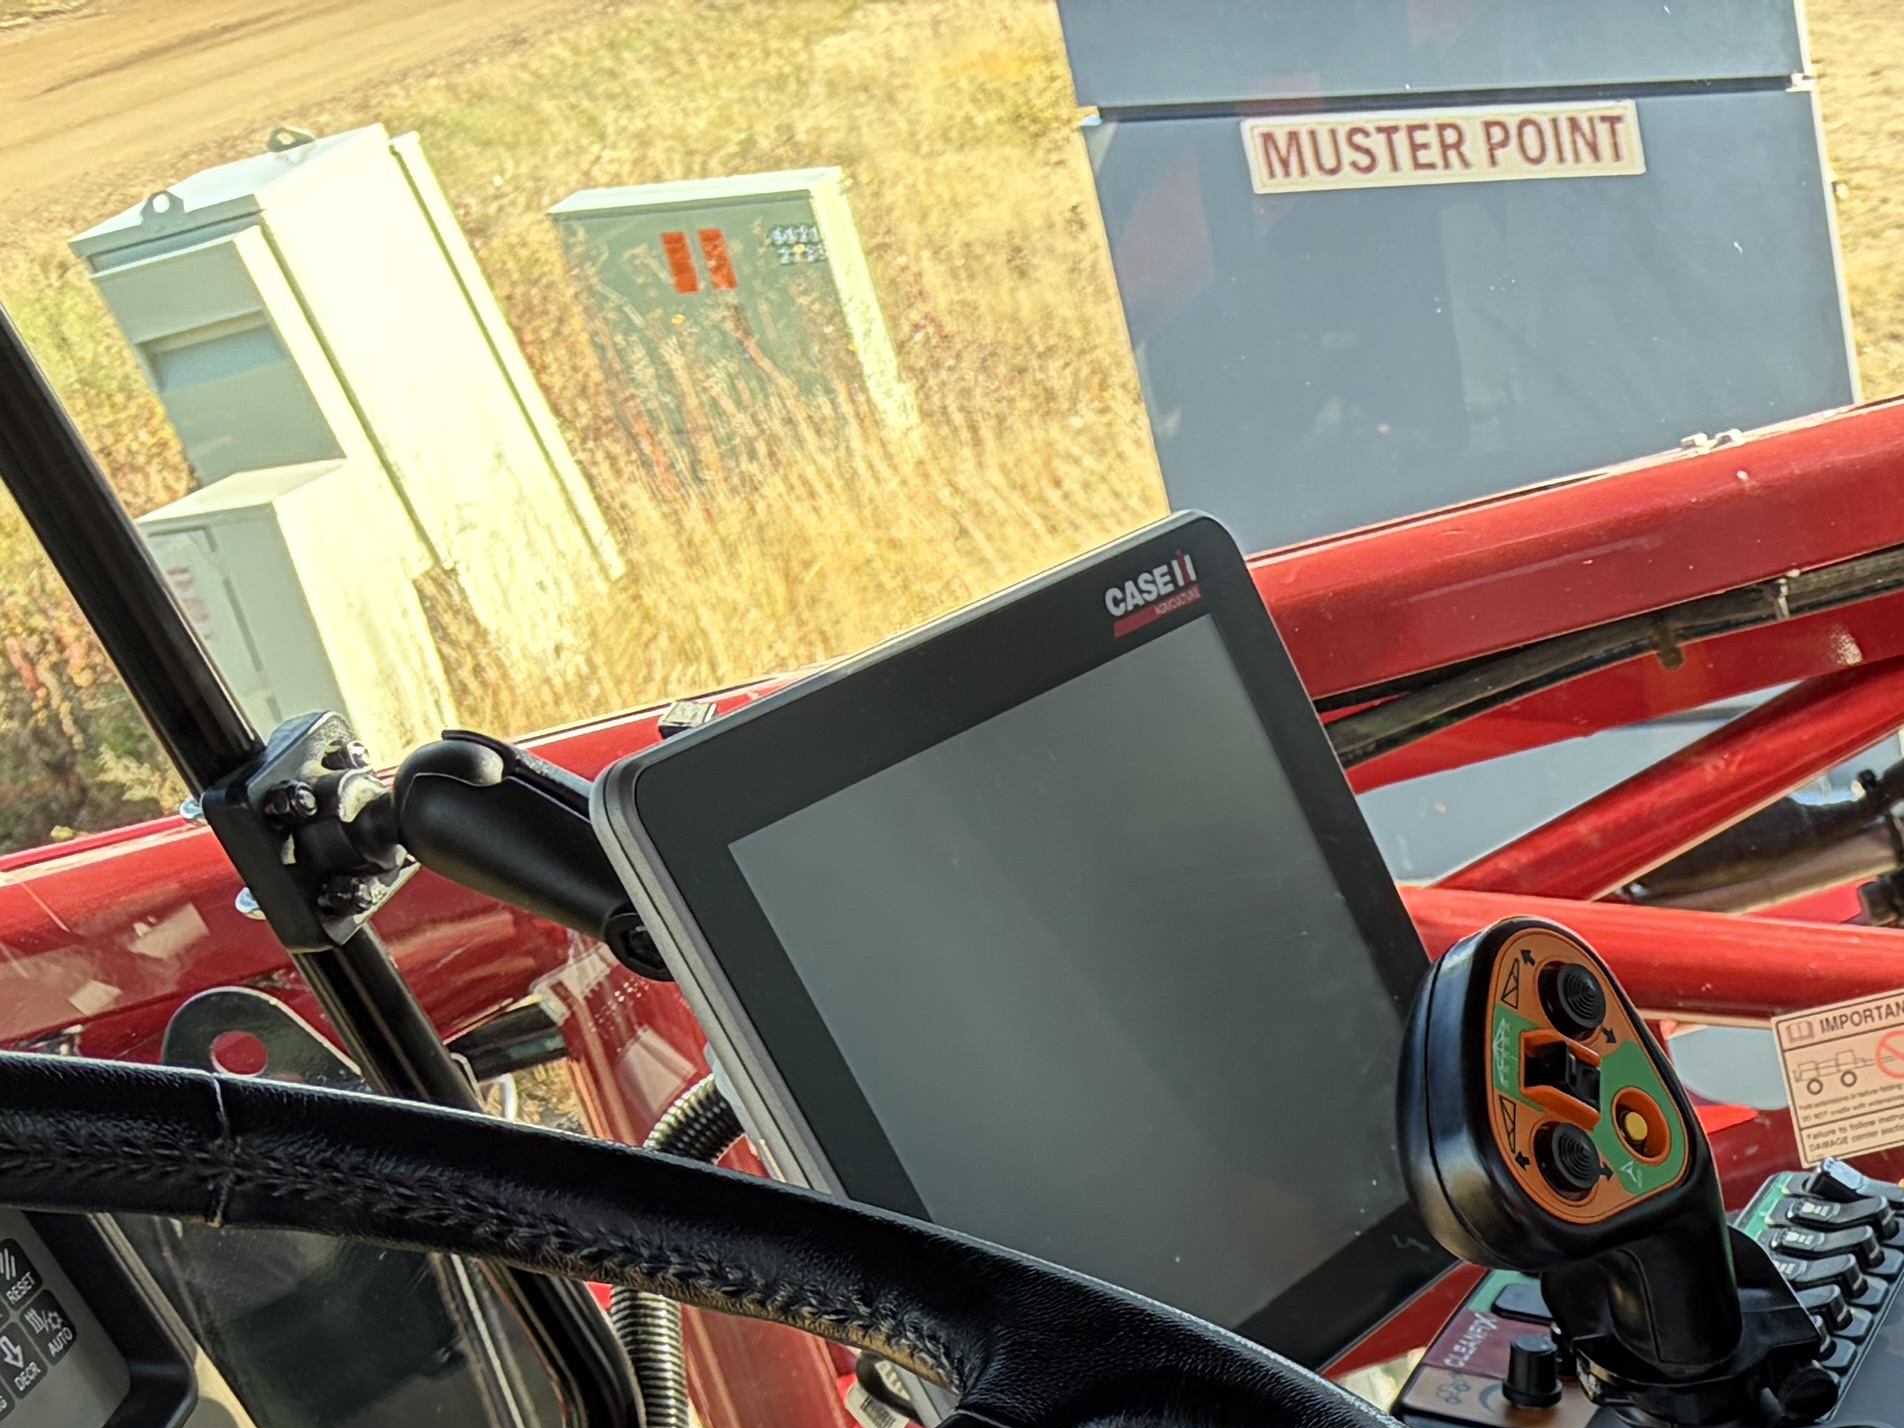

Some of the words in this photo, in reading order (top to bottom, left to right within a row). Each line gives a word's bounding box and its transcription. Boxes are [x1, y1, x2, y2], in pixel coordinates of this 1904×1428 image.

[1259, 121, 1474, 180] MUSTER
[1482, 114, 1625, 169] POINT
[1104, 564, 1175, 617] CASE
[5, 1271, 36, 1305] RESET
[47, 1327, 74, 1357] AUTO
[13, 1361, 42, 1392] DECR
